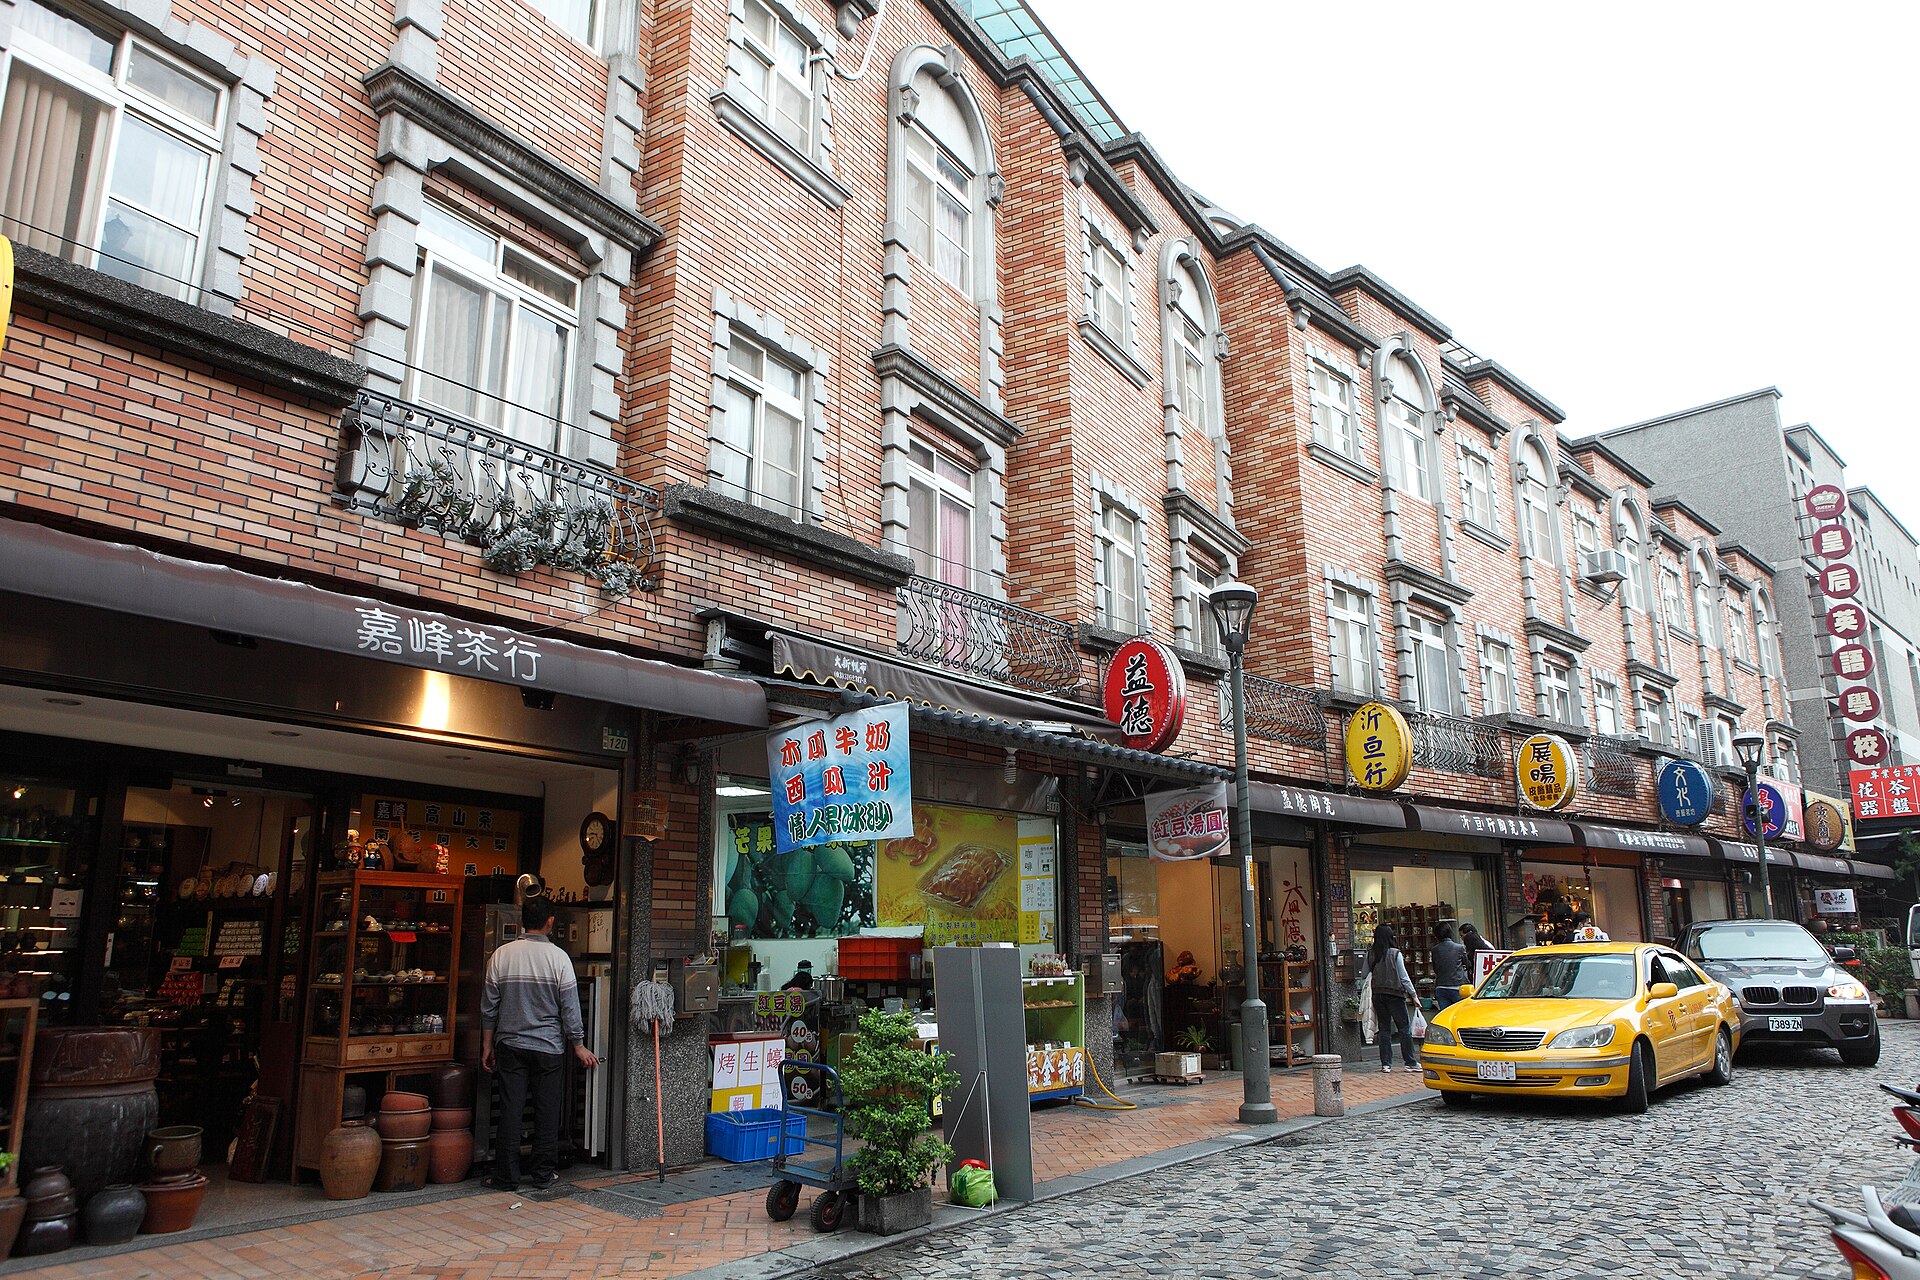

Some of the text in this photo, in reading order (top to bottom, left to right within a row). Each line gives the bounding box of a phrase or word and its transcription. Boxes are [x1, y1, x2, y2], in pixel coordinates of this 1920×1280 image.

[355, 607, 542, 681] 嘉峰茶行
[1820, 525, 1880, 759] 皇后英語學校
[1121, 652, 1154, 734] 益德
[610, 738, 627, 749] 120
[780, 721, 890, 767] 木瓜牛奶
[785, 761, 894, 805] 西瓜汁
[1673, 766, 1691, 807] 文化
[1857, 782, 1879, 816] 花器
[1887, 779, 1912, 814] 茶盤
[375, 801, 407, 820] 嘉峰
[425, 803, 494, 829] 高山茶
[1280, 789, 1335, 815] 益德陶瓷
[788, 801, 893, 843] 情人果冰沙
[1151, 810, 1224, 841] 紅豆湯圓
[734, 826, 768, 854] 芒果
[757, 994, 804, 1015] 紅豆湯
[1770, 1019, 1803, 1030] 7389-ZN
[717, 1048, 783, 1074] 烤生蠔
[1040, 1051, 1083, 1087] 金牛角
